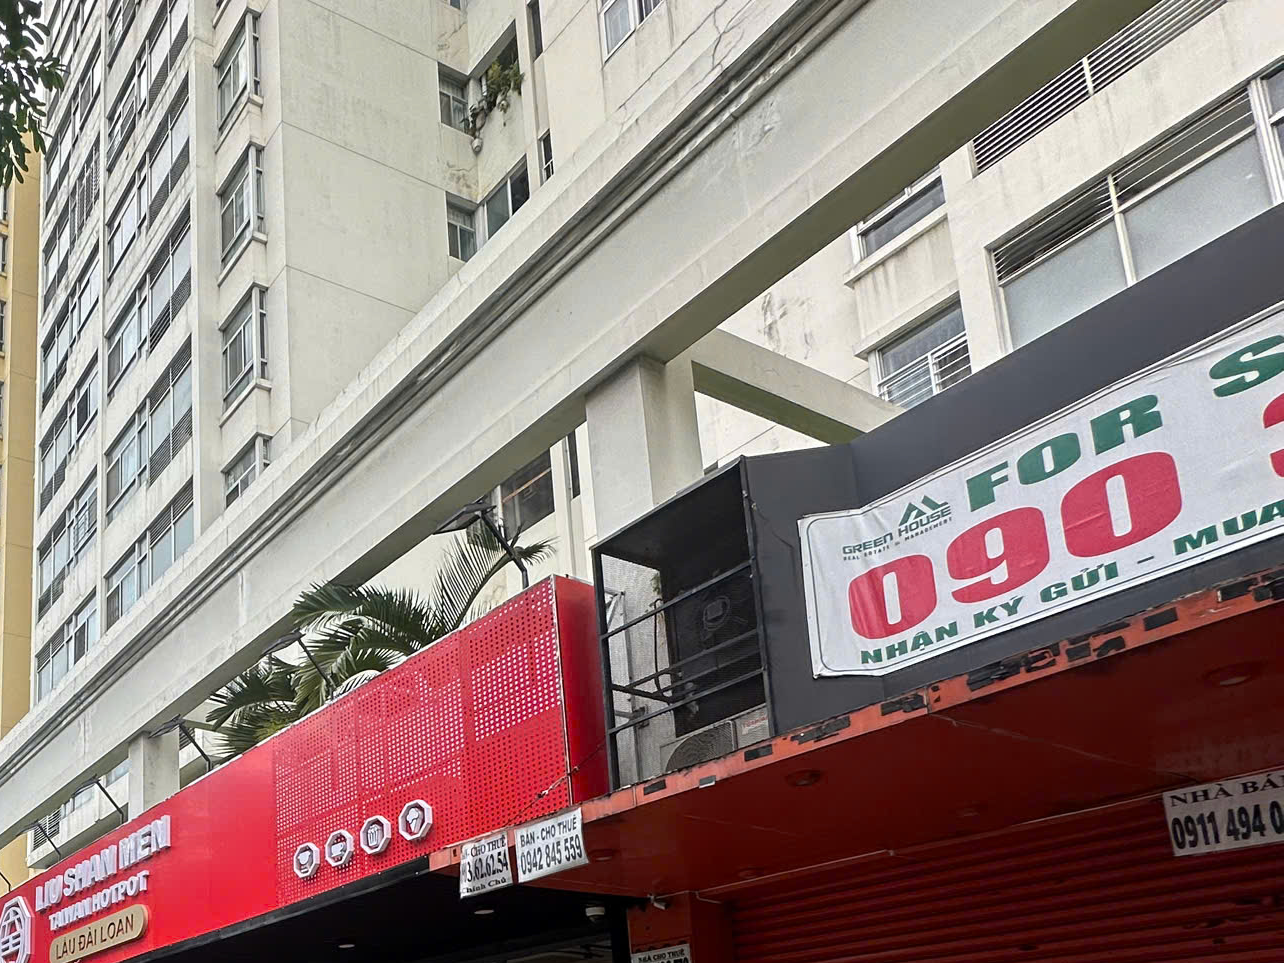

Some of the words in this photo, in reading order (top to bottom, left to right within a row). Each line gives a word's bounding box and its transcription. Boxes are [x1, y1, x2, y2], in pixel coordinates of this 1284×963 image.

[966, 394, 1163, 512] FOR
[842, 532, 893, 555] GREEN
[898, 505, 952, 537] HOUSE
[848, 451, 1183, 640] 090
[904, 516, 953, 541] MANAGEMENT
[860, 621, 959, 665] NHẬN
[973, 596, 1025, 629] KÝ
[1172, 500, 1284, 555] MUA
[1170, 783, 1234, 807] NHÀ
[1240, 774, 1284, 795] BÁ
[470, 842, 486, 858] CHO
[487, 834, 506, 853] THUÊ
[540, 824, 556, 841] CHO
[557, 814, 577, 835] THUÊ
[1172, 811, 1220, 850] 0911
[1227, 804, 1266, 841] 494
[35, 875, 63, 912] LIU
[63, 845, 117, 897] SHAN
[119, 815, 171, 870] MEN
[520, 847, 544, 875] 0942
[545, 840, 562, 868] 845
[564, 834, 583, 862] 559
[48, 897, 92, 931] TAIWAN
[92, 870, 150, 912] HOTPOT
[78, 925, 97, 951] ĐÀI
[100, 913, 134, 943] LOAN
[653, 952, 667, 961] CHO
